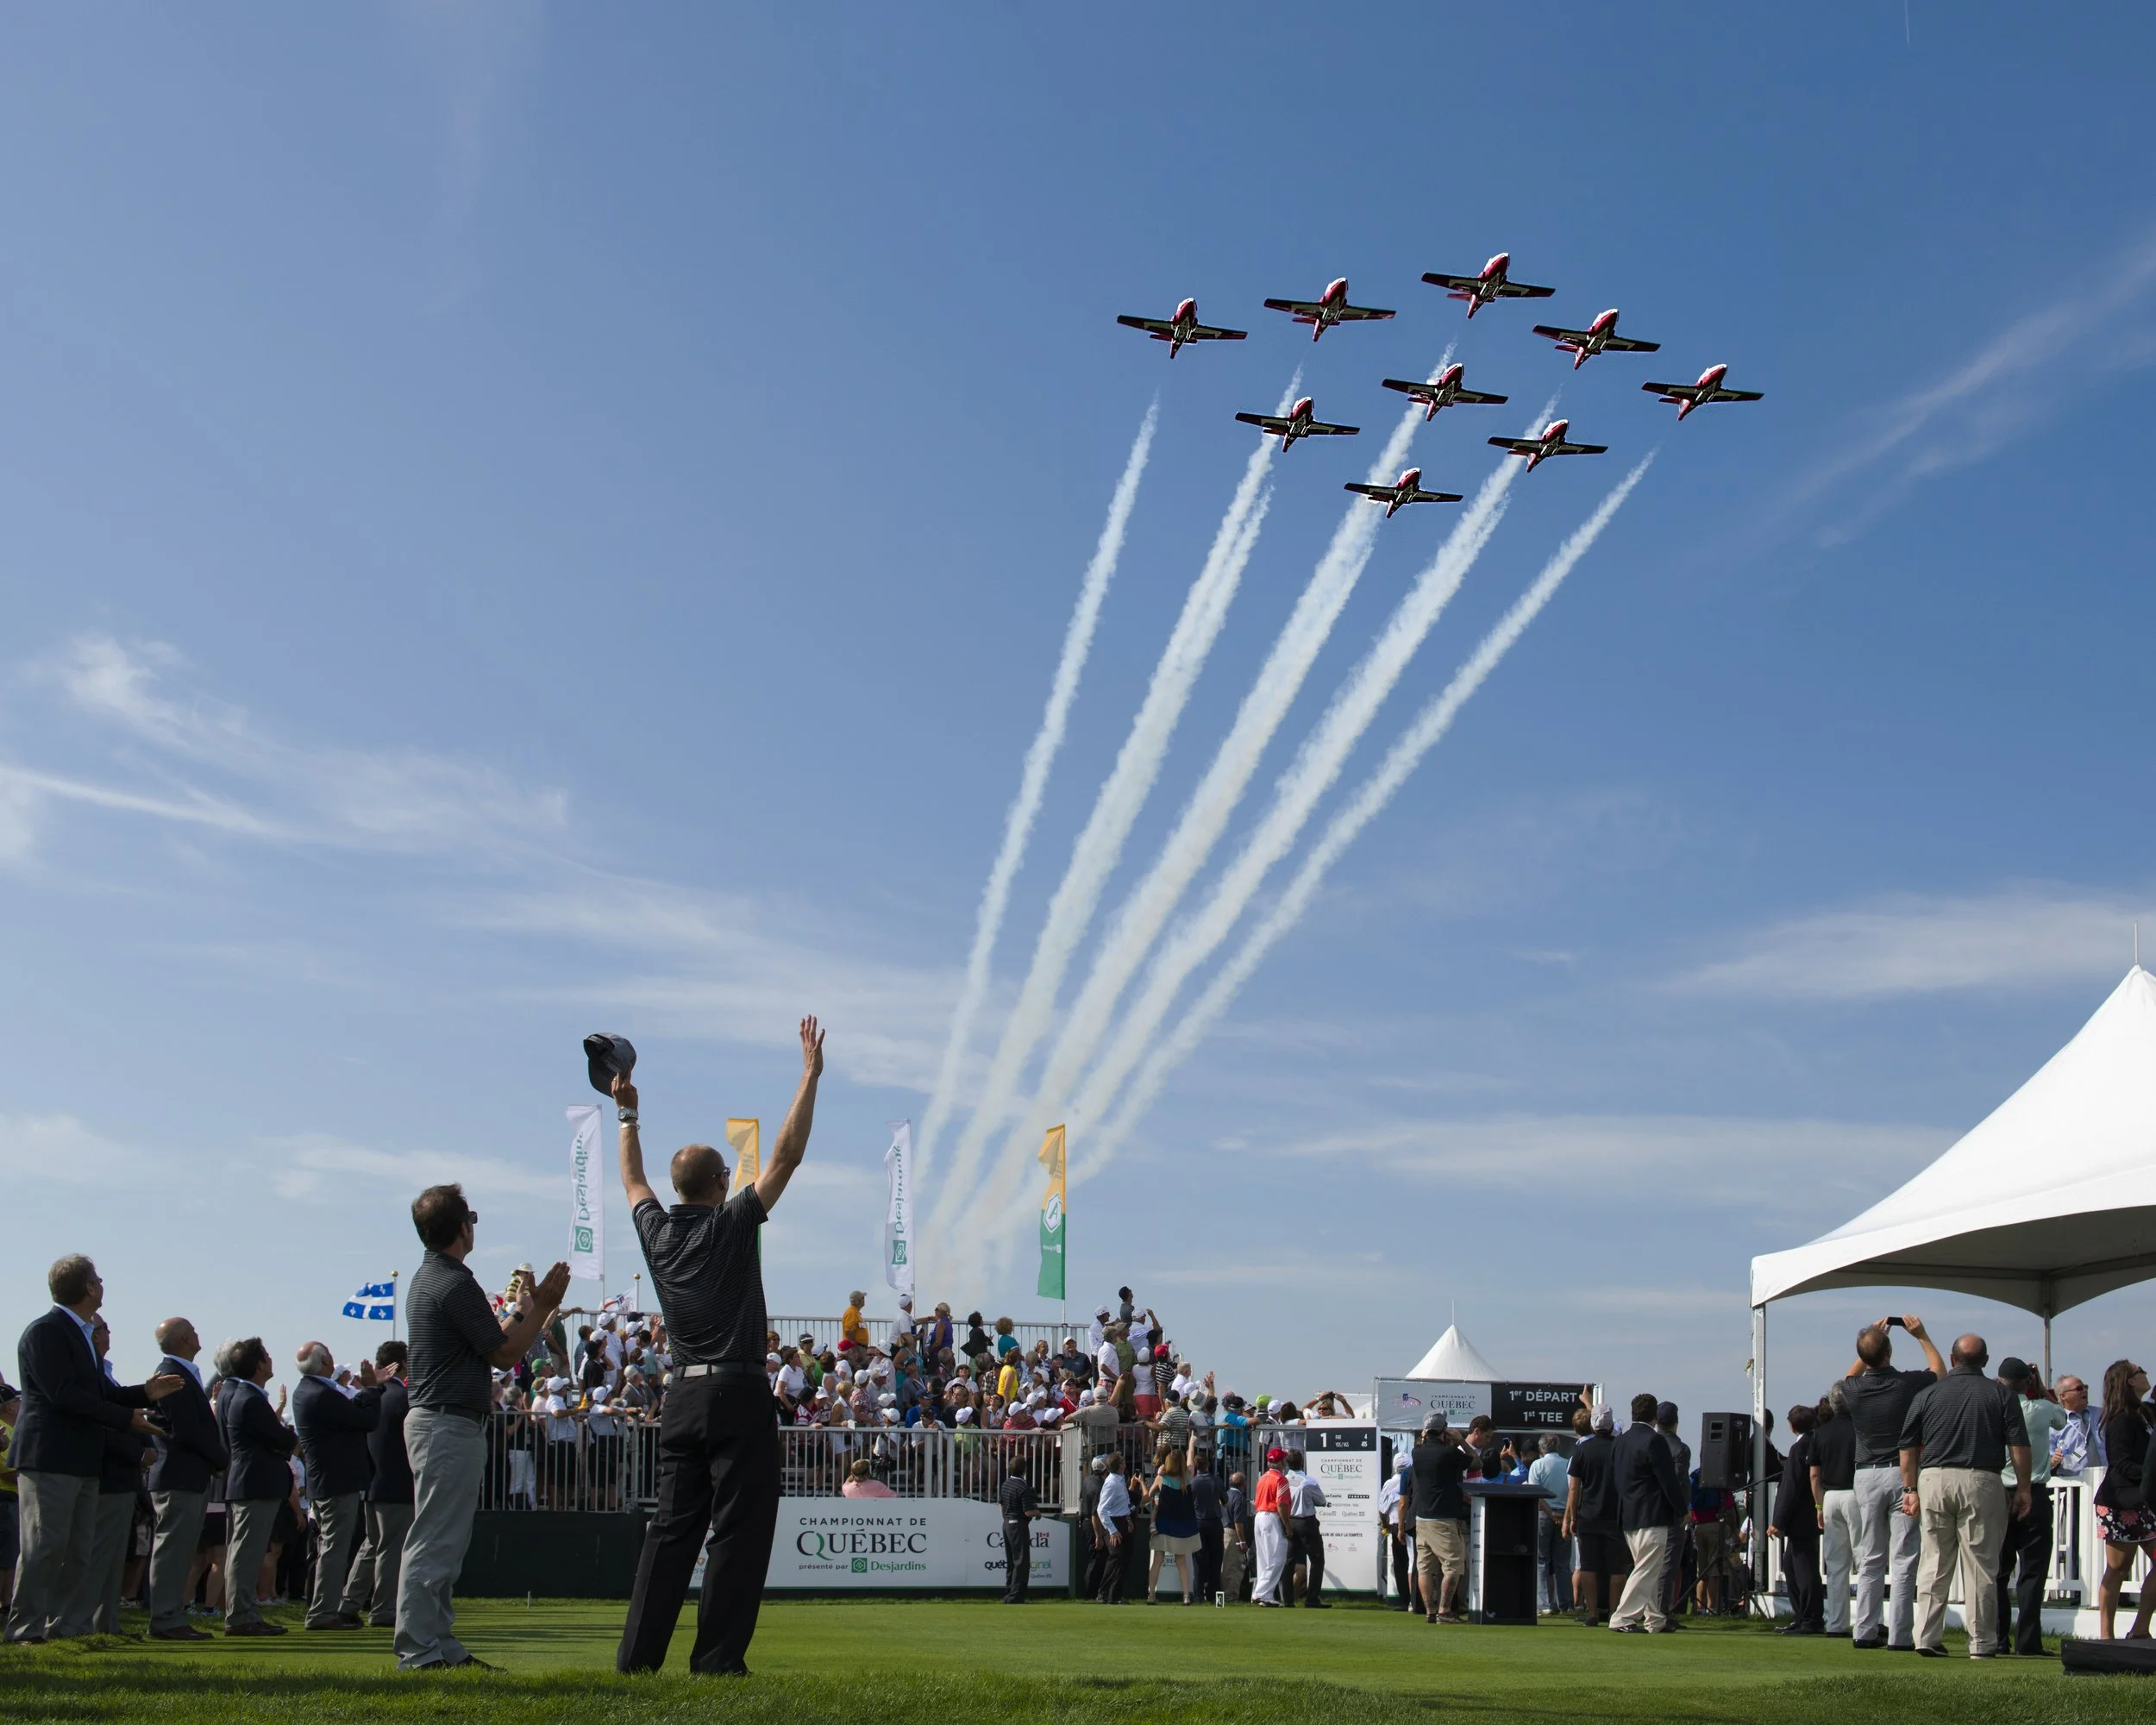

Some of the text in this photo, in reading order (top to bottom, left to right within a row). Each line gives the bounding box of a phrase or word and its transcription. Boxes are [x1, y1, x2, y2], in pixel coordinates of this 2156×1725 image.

[1509, 1389, 1577, 1402] 1er DÉPART
[1430, 1398, 1476, 1409] QUÉBEC
[1523, 1410, 1564, 1422] 1st TEE
[1320, 1433, 1326, 1447] 1
[1320, 1462, 1363, 1475] QUÉBEC
[799, 1517, 903, 1526] CHAMPIONNAT
[796, 1528, 927, 1561] QUÉBEC
[987, 1532, 1049, 1548] Cada
[871, 1561, 927, 1572] Desjardins
